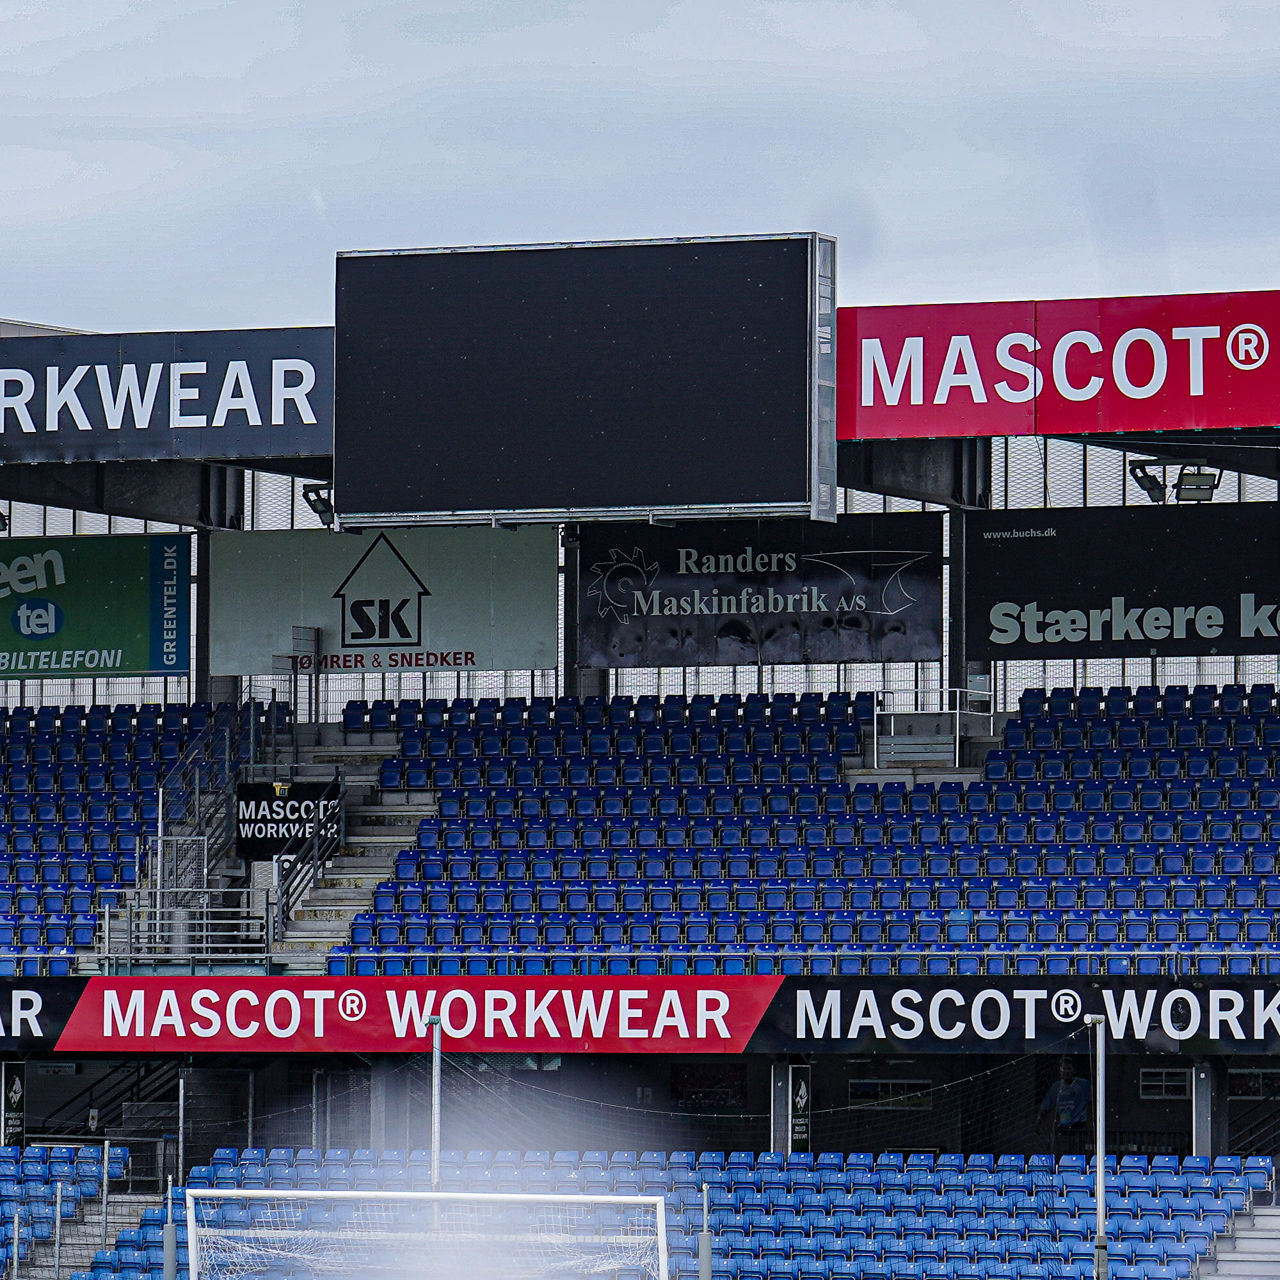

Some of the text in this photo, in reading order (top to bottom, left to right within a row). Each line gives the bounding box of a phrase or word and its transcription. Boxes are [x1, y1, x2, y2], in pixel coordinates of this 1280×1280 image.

[983, 527, 1056, 540] www.buchs.dk
[677, 547, 797, 574] Randers
[164, 545, 177, 665] GREENTEL.DK
[632, 587, 866, 616] Maskinfabrik A/S
[18, 603, 56, 634] tel
[351, 598, 413, 639] SK
[989, 596, 1224, 644] Stærkere
[371, 655, 382, 667] &
[388, 652, 476, 668] SNEDKER
[386, 989, 732, 1039] WORKWEAR
